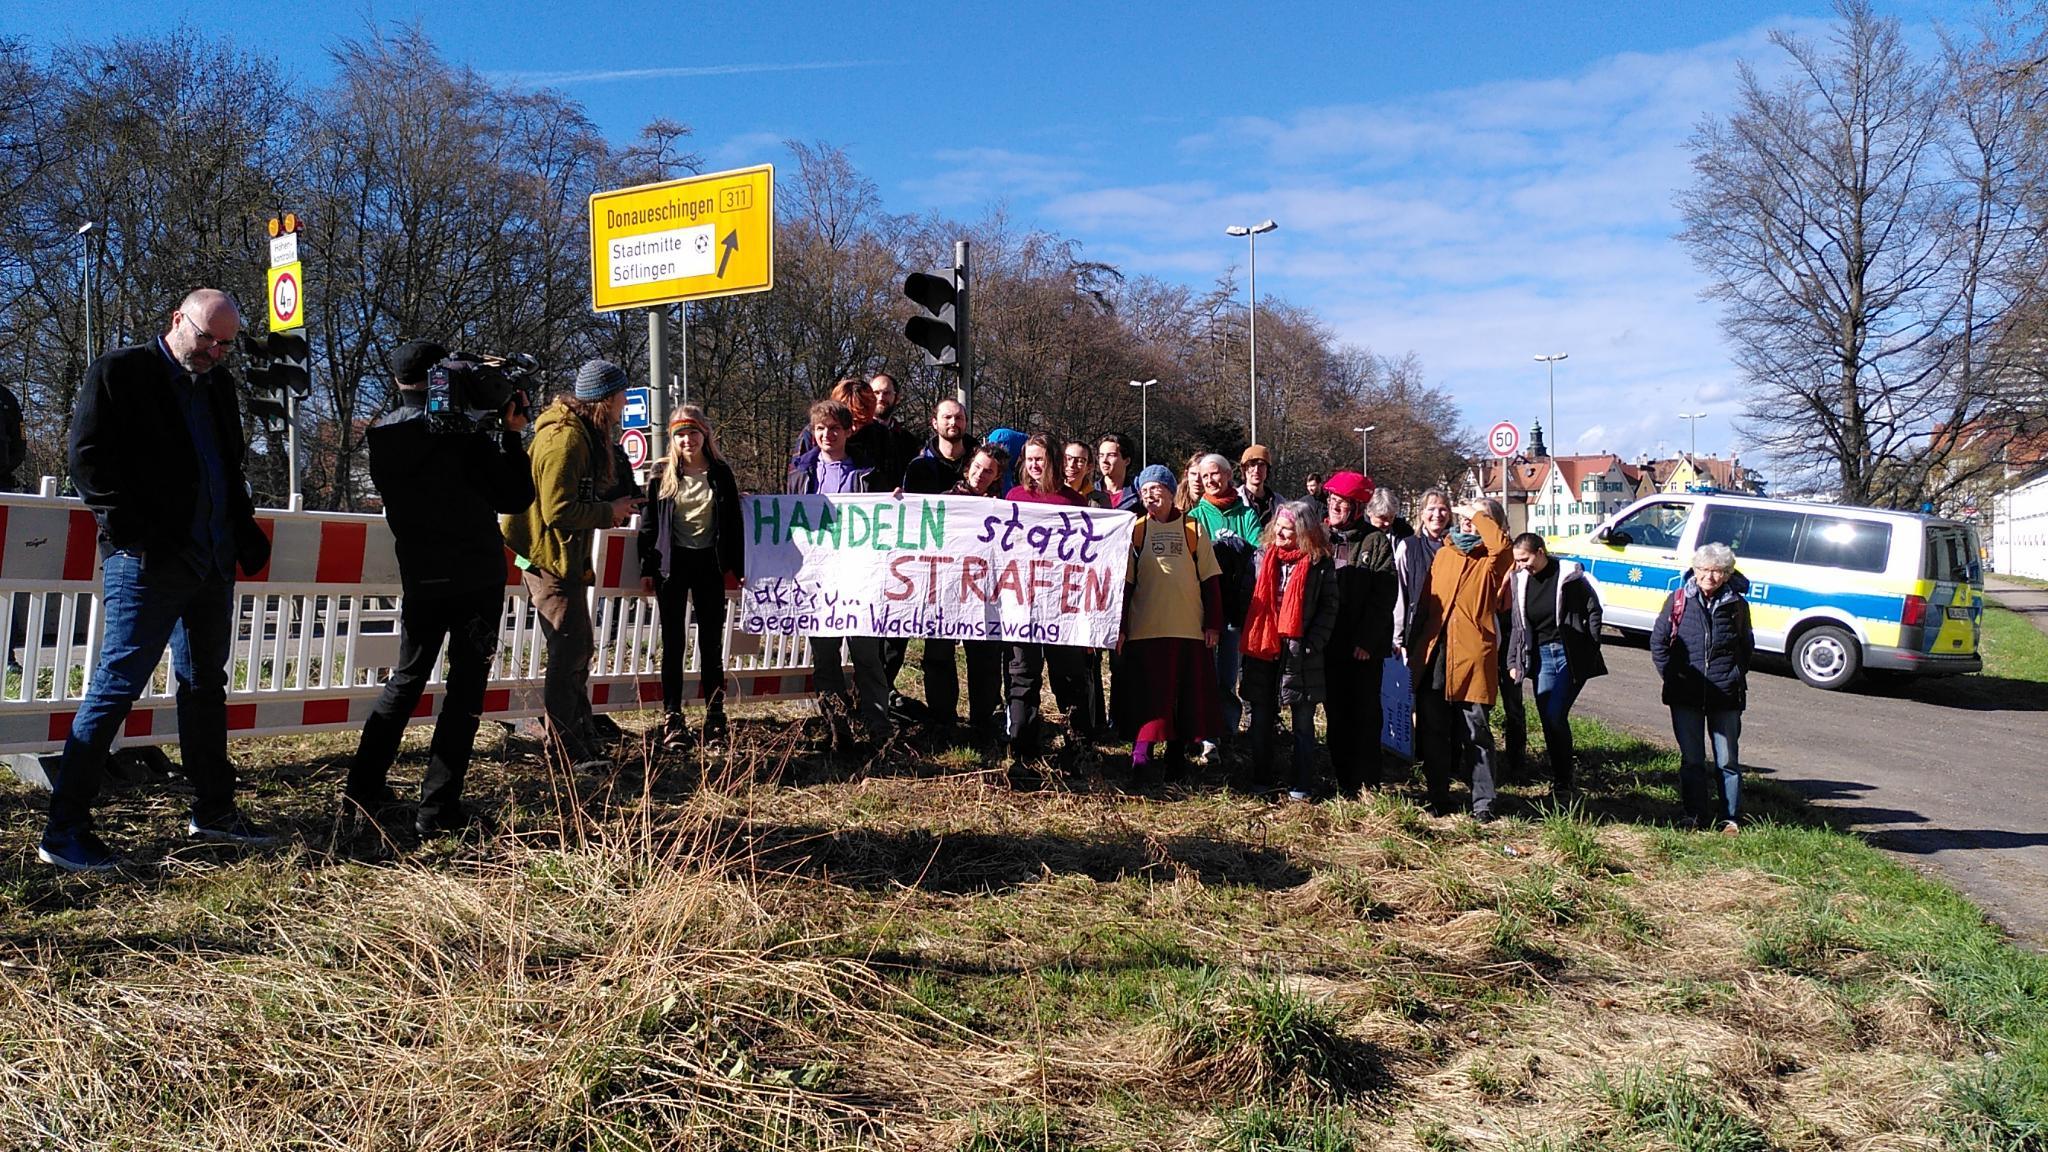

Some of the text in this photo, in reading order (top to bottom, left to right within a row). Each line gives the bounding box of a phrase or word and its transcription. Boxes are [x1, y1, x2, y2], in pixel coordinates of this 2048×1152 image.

[607, 190, 746, 229] Donaueschingen 311
[613, 237, 682, 259] Stadtmitte
[613, 261, 675, 282] Söflingen
[1496, 432, 1512, 447] 50
[754, 498, 1104, 563] HANDELN statt
[884, 555, 1111, 614] STRAFEN
[749, 604, 1060, 642] gegen den Wachstumszwang
